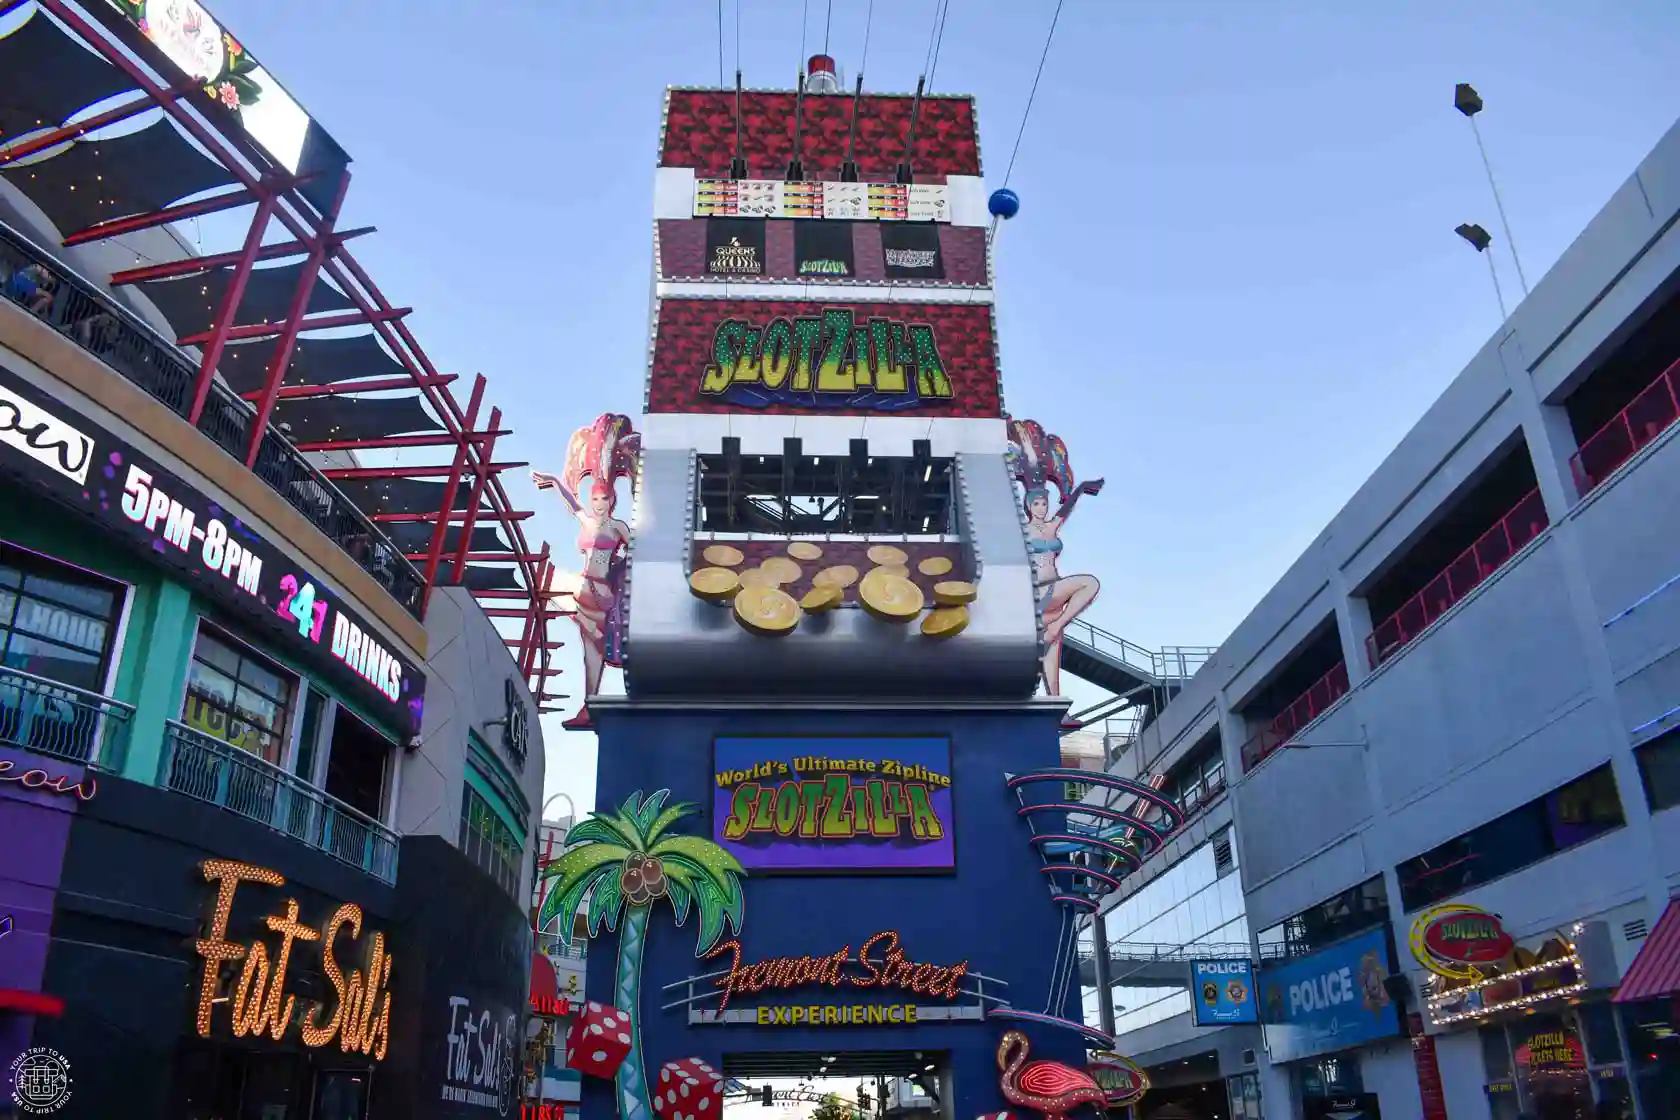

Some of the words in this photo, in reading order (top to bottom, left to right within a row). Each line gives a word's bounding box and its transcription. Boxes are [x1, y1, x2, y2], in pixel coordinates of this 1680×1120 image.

[716, 247, 756, 256] QUEENS
[699, 308, 954, 398] SLOTZILLA
[121, 464, 263, 597] 5PM-8PM
[331, 610, 402, 703] DRINKS
[715, 761, 788, 787] World's
[793, 756, 876, 773] Ultimate
[882, 759, 951, 787] Zipline
[722, 774, 944, 840] SLOTZILLA
[195, 859, 321, 1040] Fat
[705, 939, 850, 1020] Fremont
[850, 929, 969, 1000] Street
[1197, 962, 1248, 975] POLICE
[756, 1004, 918, 1025] EXPERIENCE
[1289, 966, 1355, 1016] POLICE
[446, 996, 479, 1082] Fat
[1554, 1047, 1574, 1062] HERE
